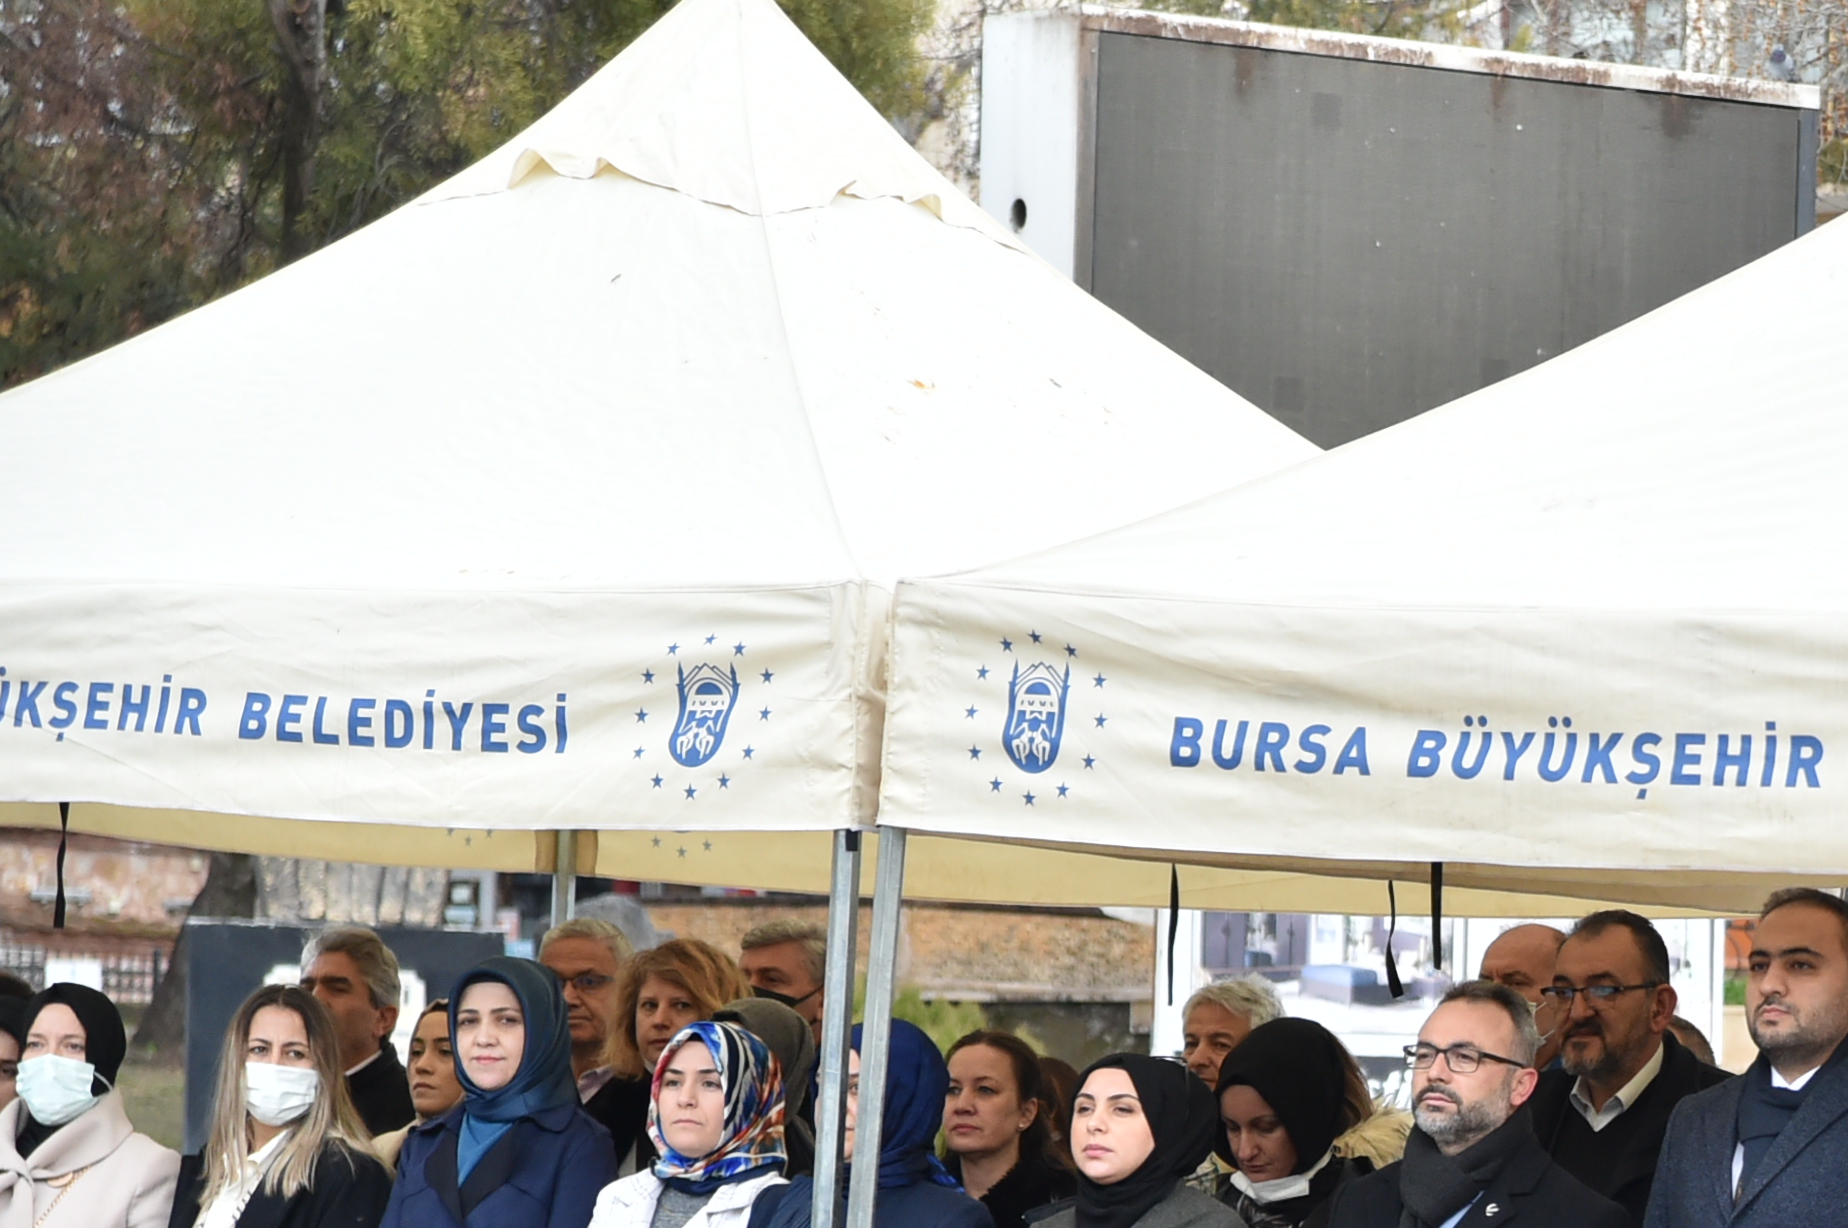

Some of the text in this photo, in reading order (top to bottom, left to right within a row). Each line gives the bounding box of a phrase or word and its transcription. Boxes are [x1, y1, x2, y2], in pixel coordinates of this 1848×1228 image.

[239, 689, 568, 753] BELEDİYESİ
[1171, 717, 1370, 775] BURSA
[1407, 715, 1825, 799] BÜYÜKŞEHİR
